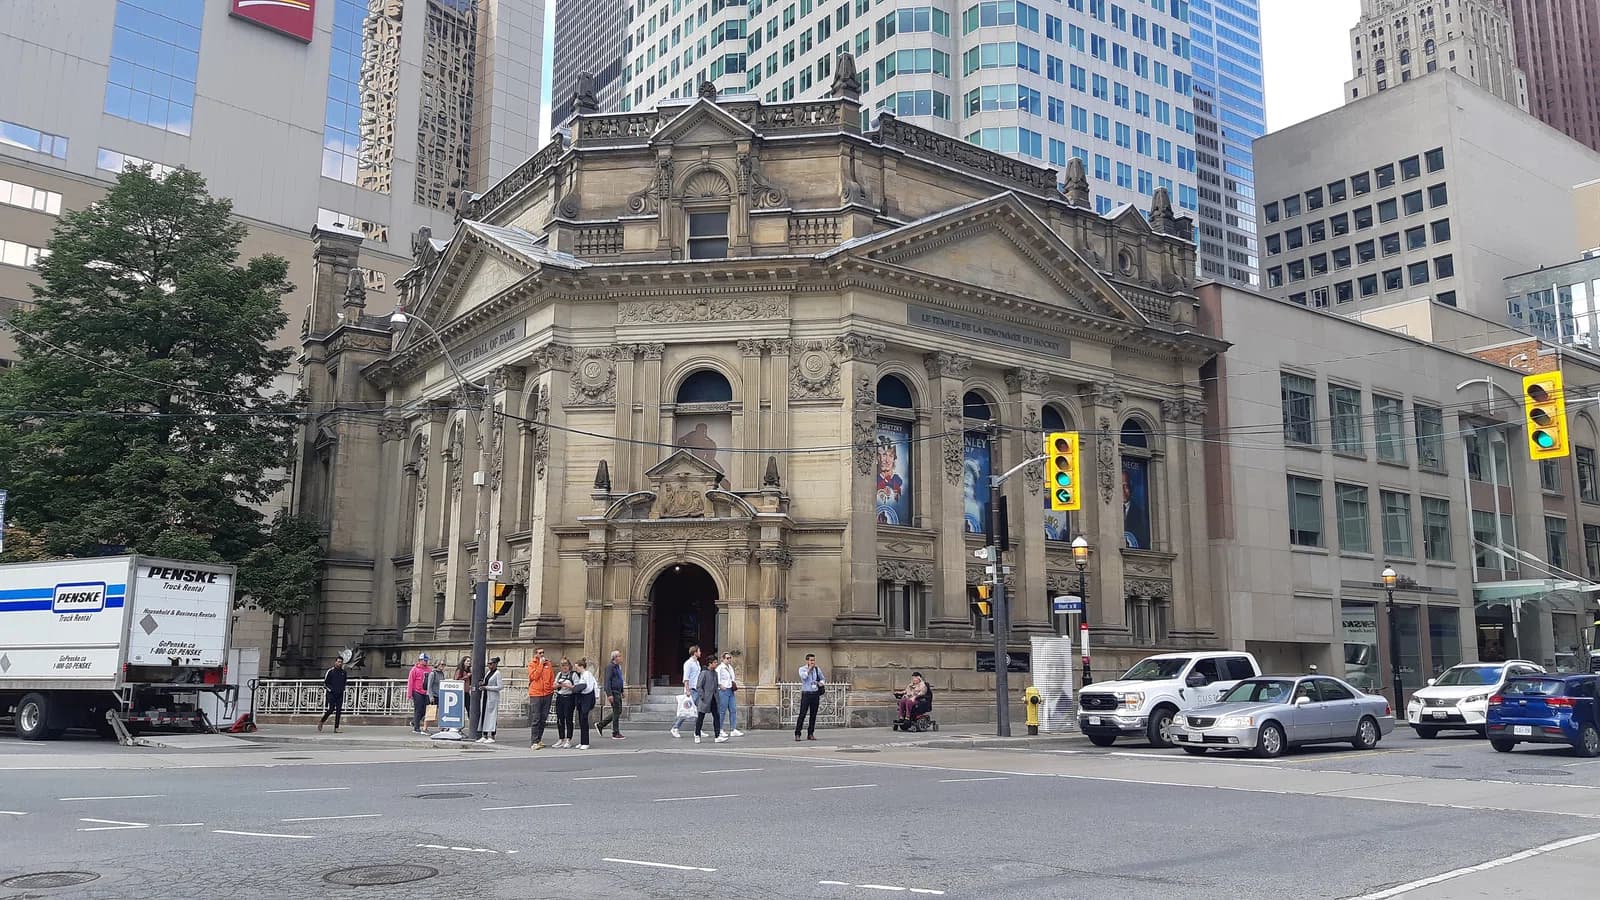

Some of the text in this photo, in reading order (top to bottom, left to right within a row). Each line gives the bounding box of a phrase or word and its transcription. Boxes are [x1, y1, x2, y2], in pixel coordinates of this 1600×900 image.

[921, 313, 931, 322] LE
[932, 315, 961, 329] TEMPLE
[962, 321, 973, 331] DE
[973, 324, 982, 334] LA
[473, 343, 488, 360] HALL
[489, 336, 499, 350] OF
[499, 327, 516, 346] FAME
[147, 566, 218, 584] PENSKE
[163, 582, 206, 593] Truck Rental
[57, 591, 102, 604] PENSKE
[59, 613, 93, 622] Truck Rental
[142, 608, 170, 616] Household
[176, 610, 199, 618] Business
[158, 640, 196, 649] GoPenske.ca
[444, 691, 458, 714] P
